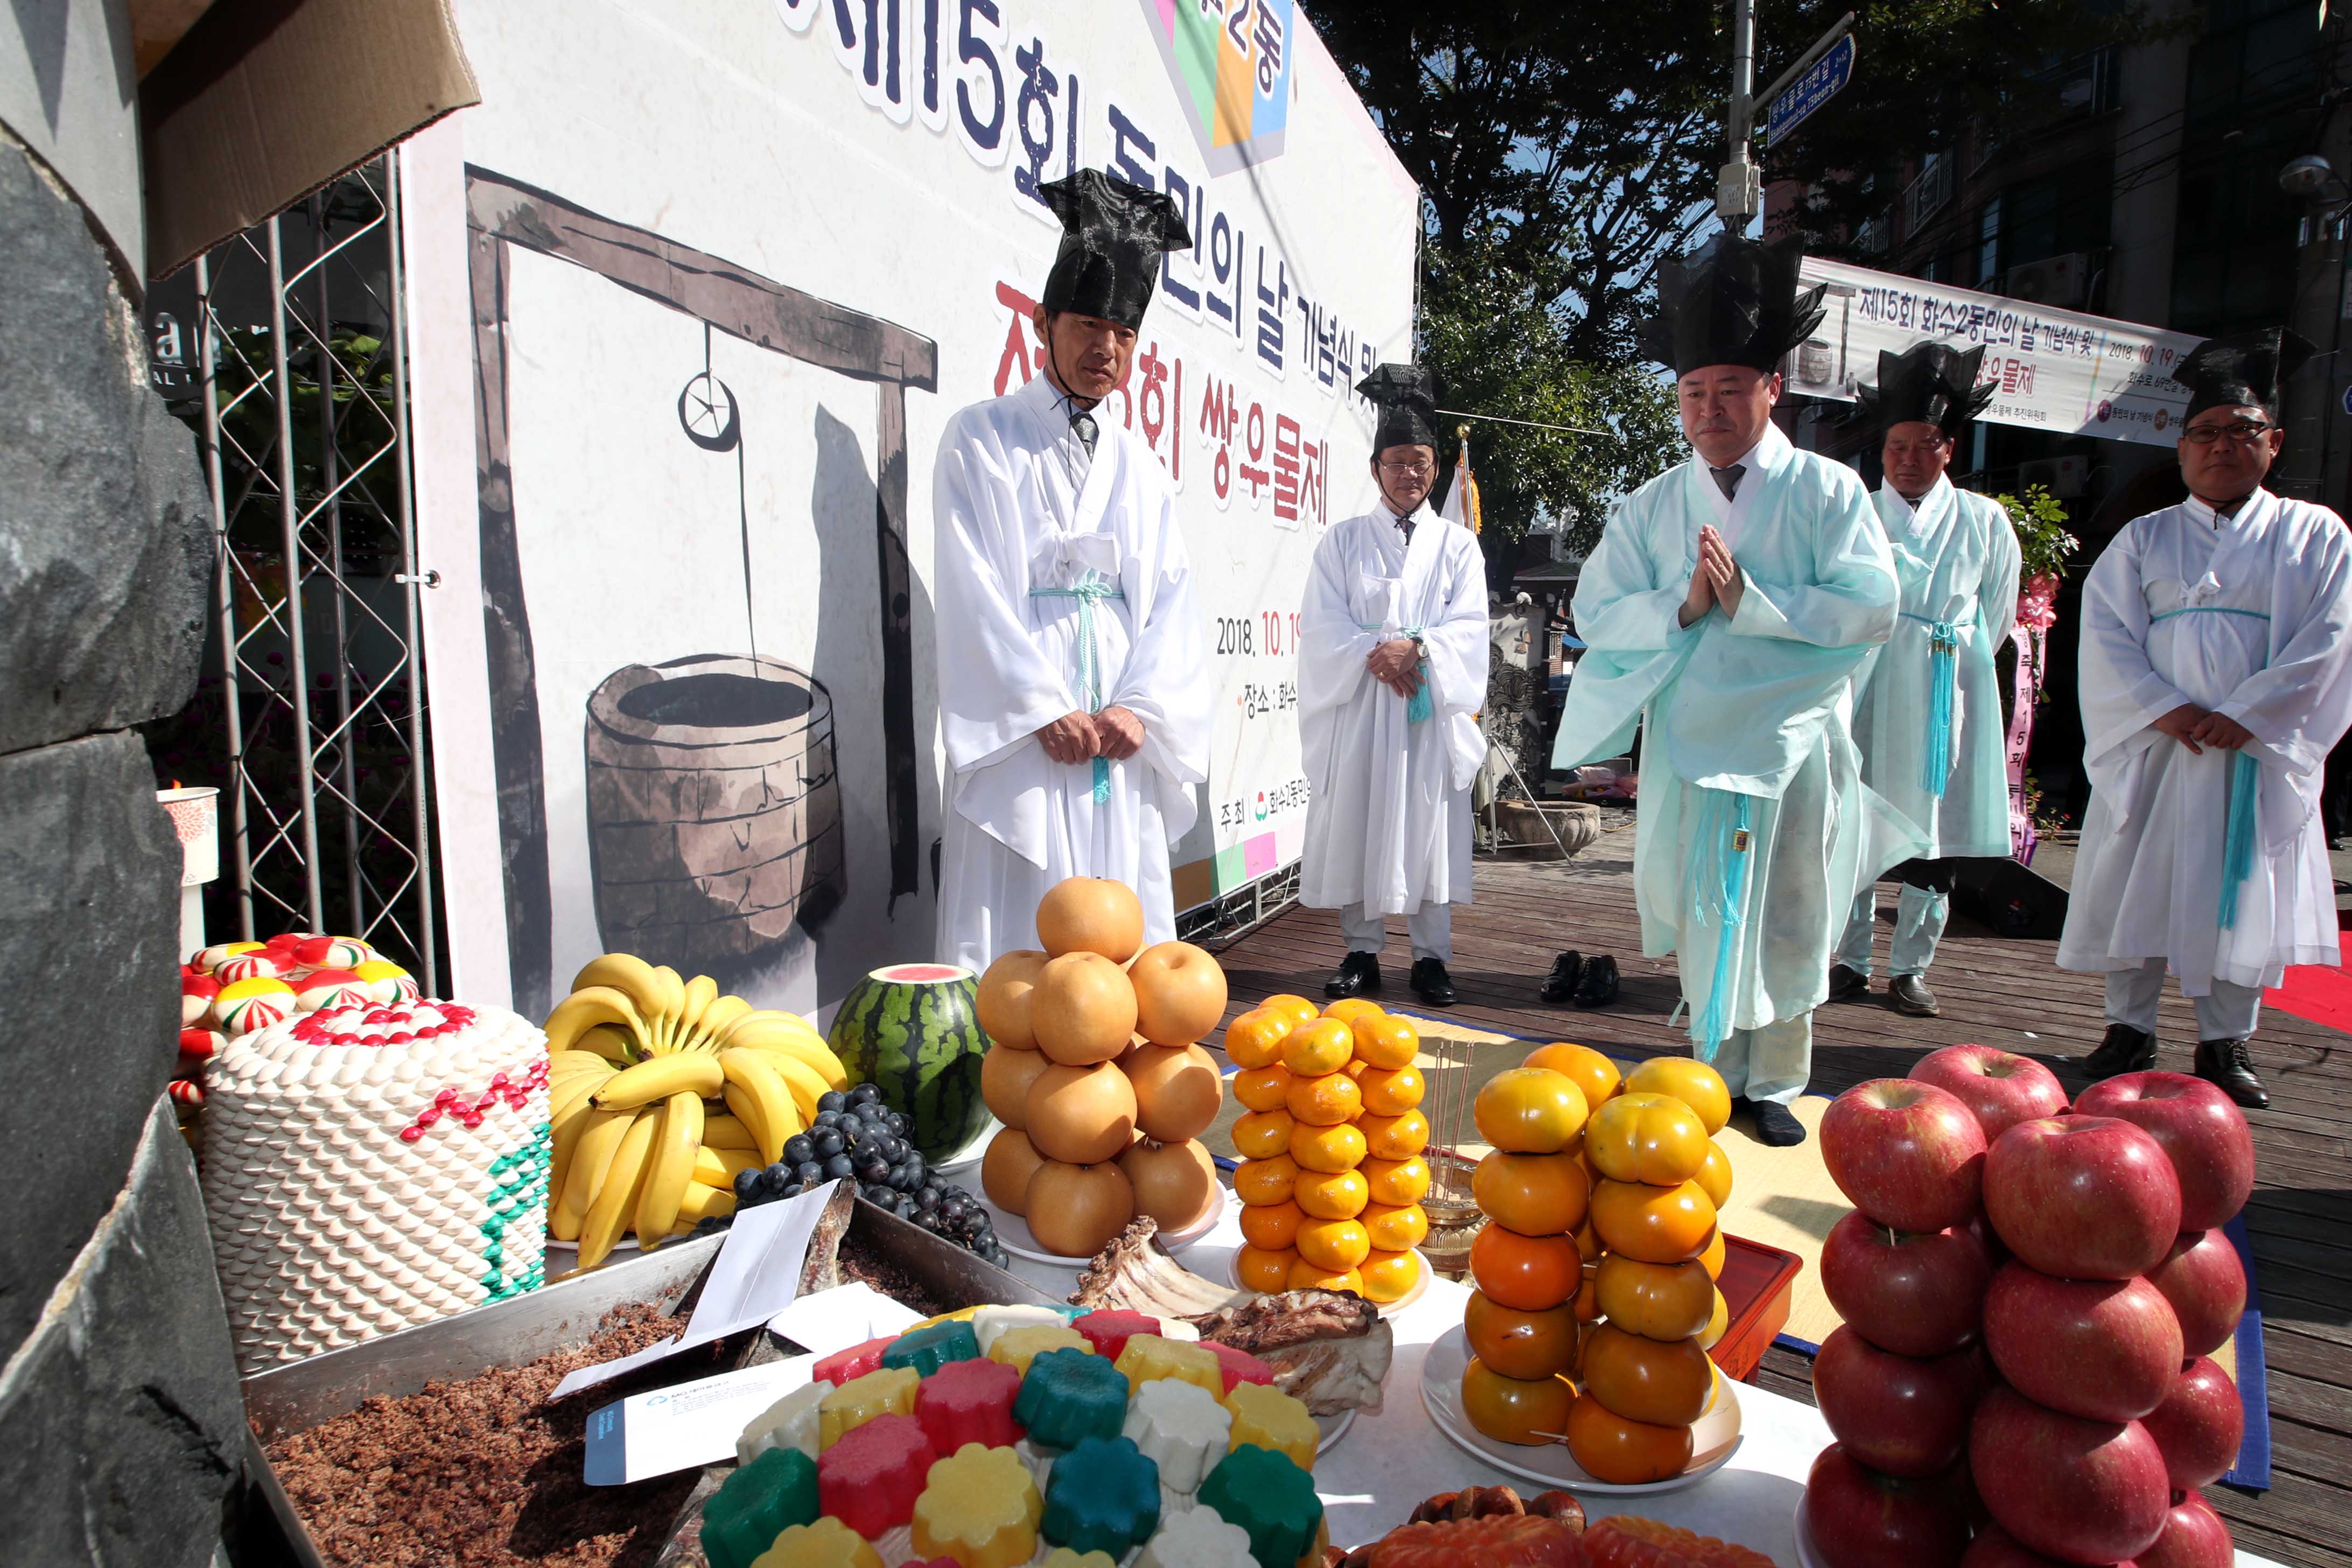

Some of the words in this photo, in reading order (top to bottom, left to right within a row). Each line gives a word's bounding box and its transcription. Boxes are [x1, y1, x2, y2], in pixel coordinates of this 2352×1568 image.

[1257, 246, 1289, 370] 날
[1297, 296, 1354, 401] 기념식
[1859, 287, 1917, 329] 제15회
[1921, 296, 2018, 347] 화수2동민의
[2020, 316, 2039, 351] 날
[2044, 325, 2078, 354] 기념식
[2080, 331, 2094, 355] 및
[2109, 342, 2133, 361] 2018.
[2140, 345, 2153, 366] 10.
[2128, 372, 2152, 386] 화수로
[1200, 373, 1328, 526] 쌍우물제
[1217, 618, 1256, 657] 2018.
[1262, 611, 1284, 657] 10.
[1244, 683, 1269, 719] 장소
[1278, 681, 1298, 711] 화수
